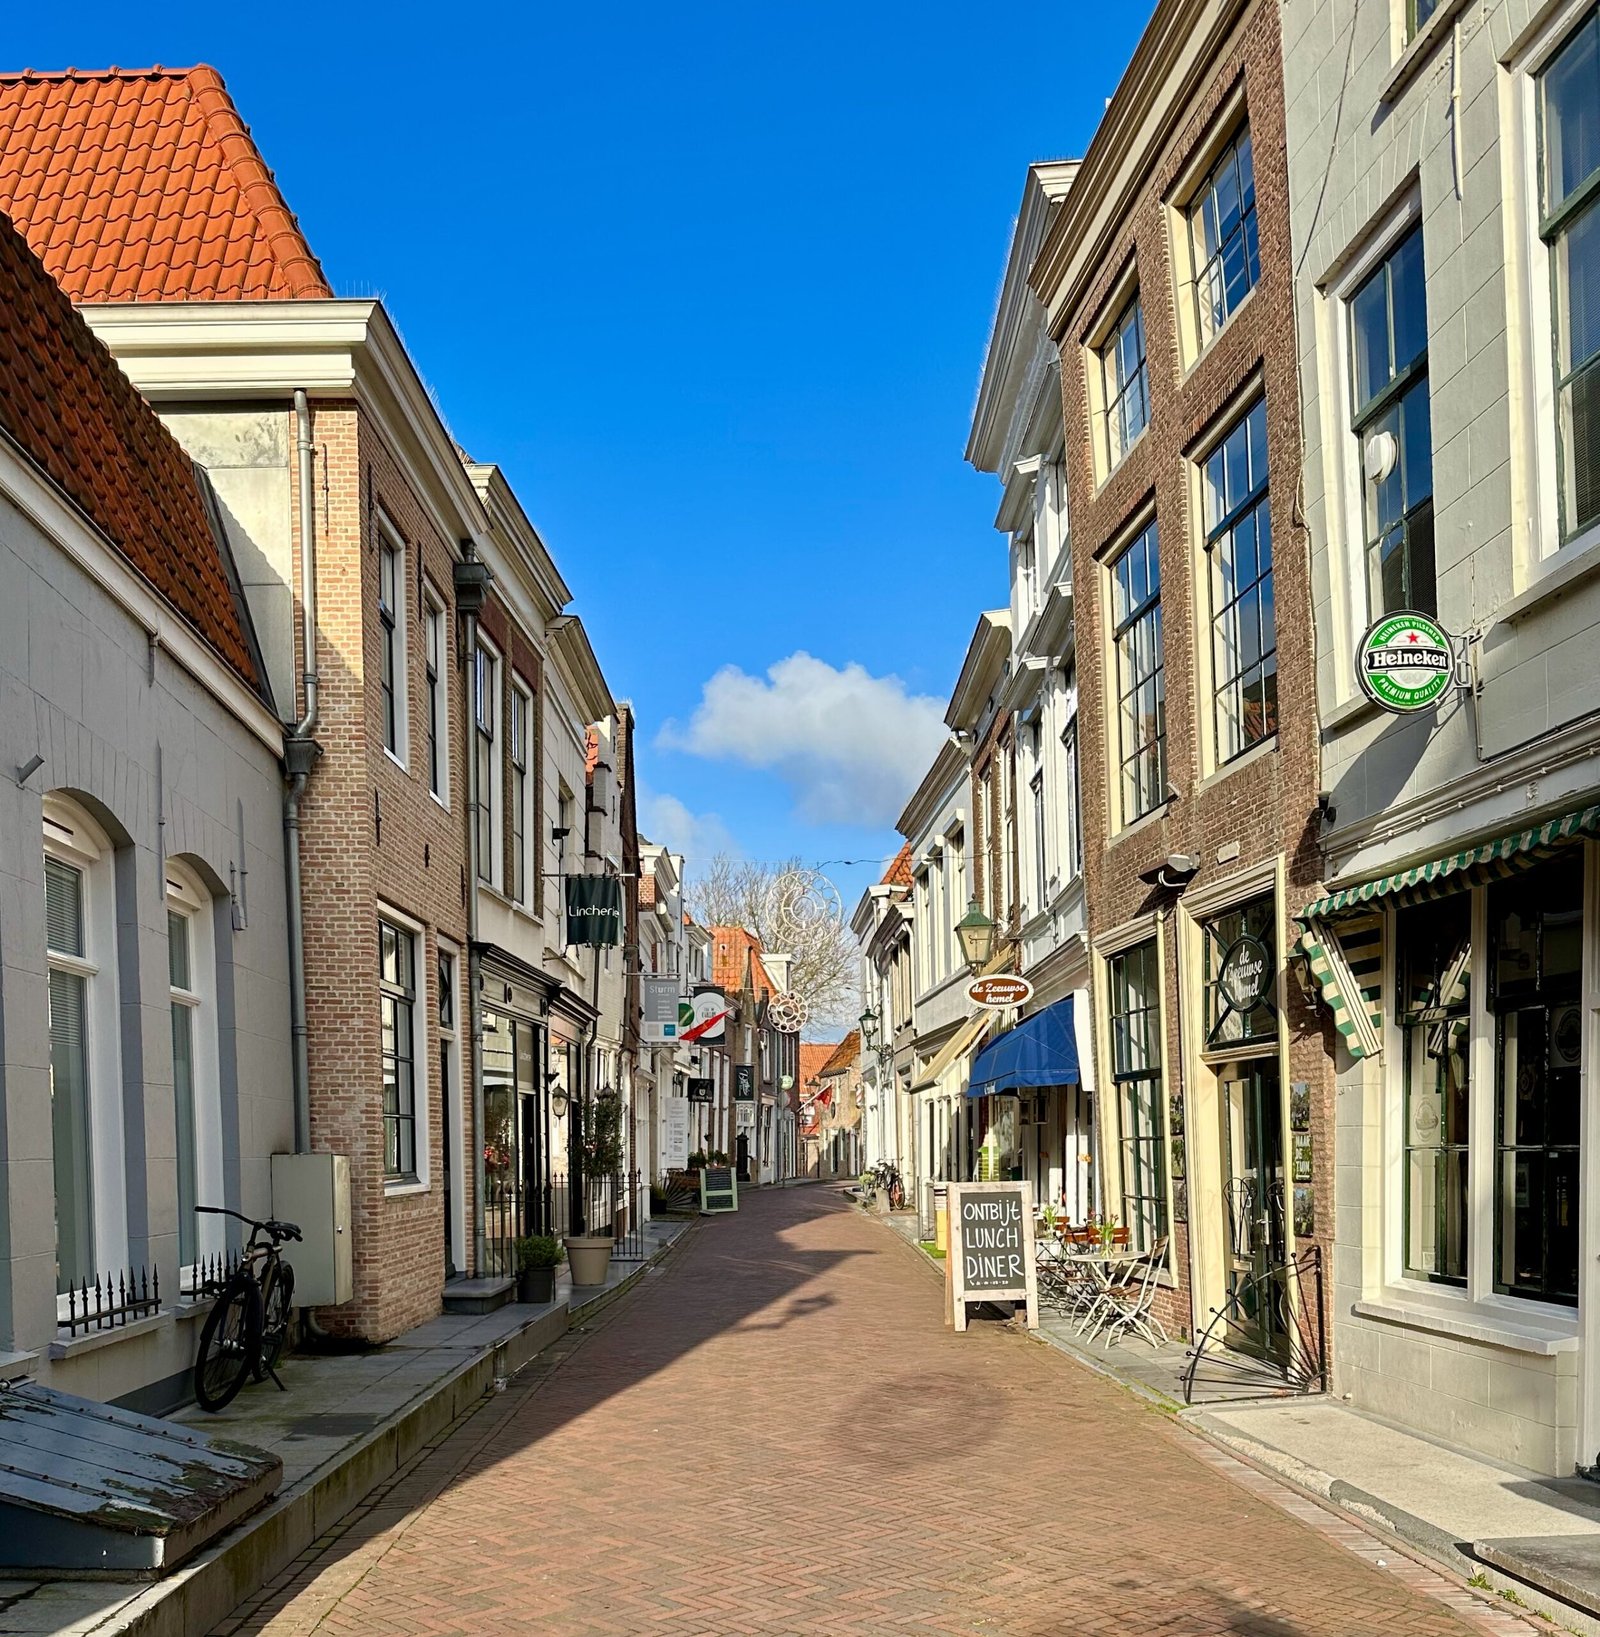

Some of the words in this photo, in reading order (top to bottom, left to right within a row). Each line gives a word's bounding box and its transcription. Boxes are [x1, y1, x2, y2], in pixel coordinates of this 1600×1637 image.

[1379, 621, 1410, 641] HEINEKEN
[1412, 621, 1440, 641] PILSENER
[1373, 650, 1446, 668] Heineken
[1378, 677, 1411, 700] PREMIUM
[1414, 677, 1441, 700] QUALITY
[568, 904, 620, 918] Lincherie
[1239, 944, 1250, 966] de
[649, 985, 676, 994] Sturm
[971, 983, 984, 994] de
[985, 983, 1026, 993] Zeeuwse
[986, 992, 1015, 1003] hemel
[966, 1227, 1018, 1248] LUNCH
